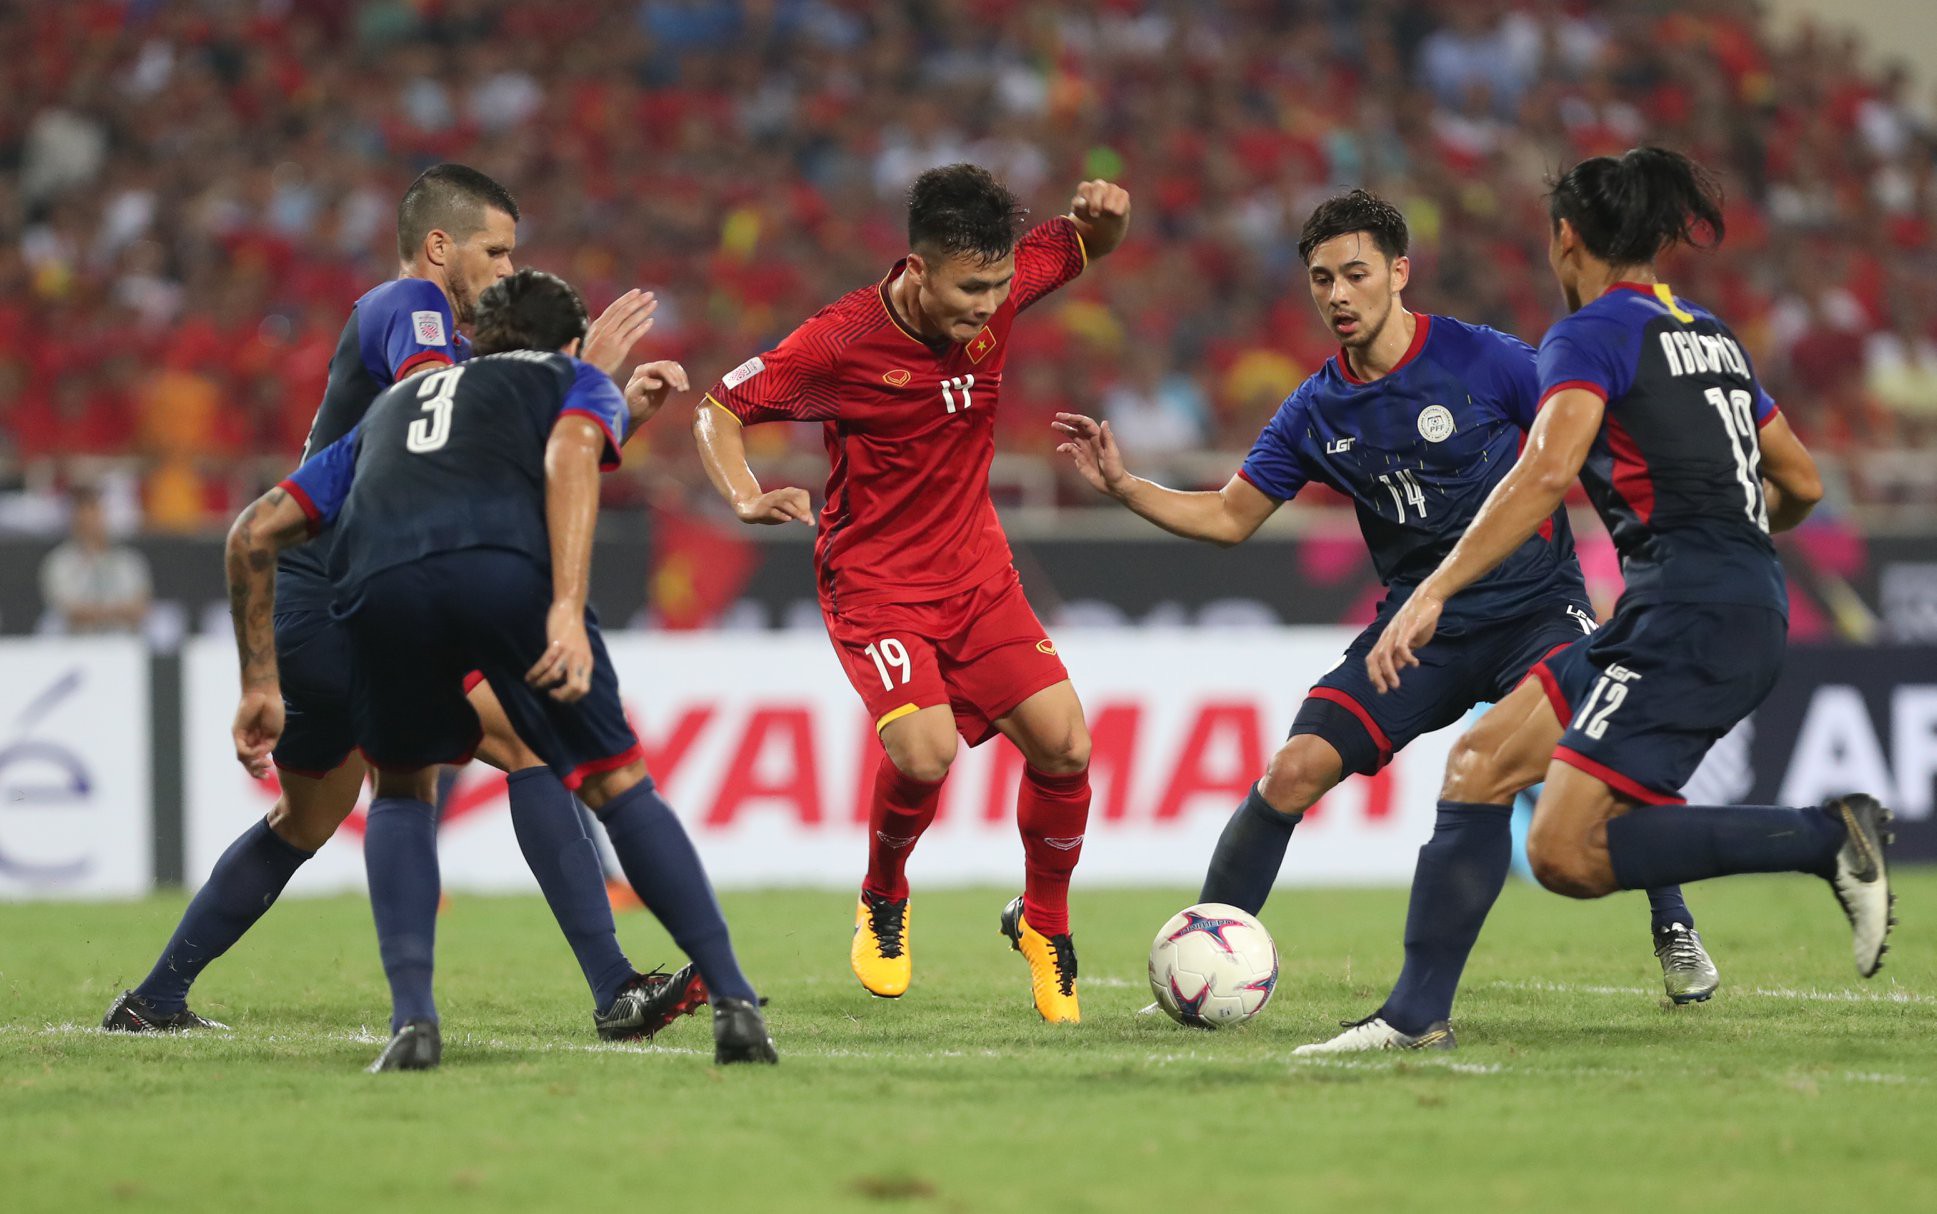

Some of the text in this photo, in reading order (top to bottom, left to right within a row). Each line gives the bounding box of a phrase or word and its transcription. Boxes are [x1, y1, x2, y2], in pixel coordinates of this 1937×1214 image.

[407, 367, 466, 453] 3
[1379, 468, 1428, 524] 14
[864, 638, 911, 692] 19
[1573, 676, 1629, 740] 12
